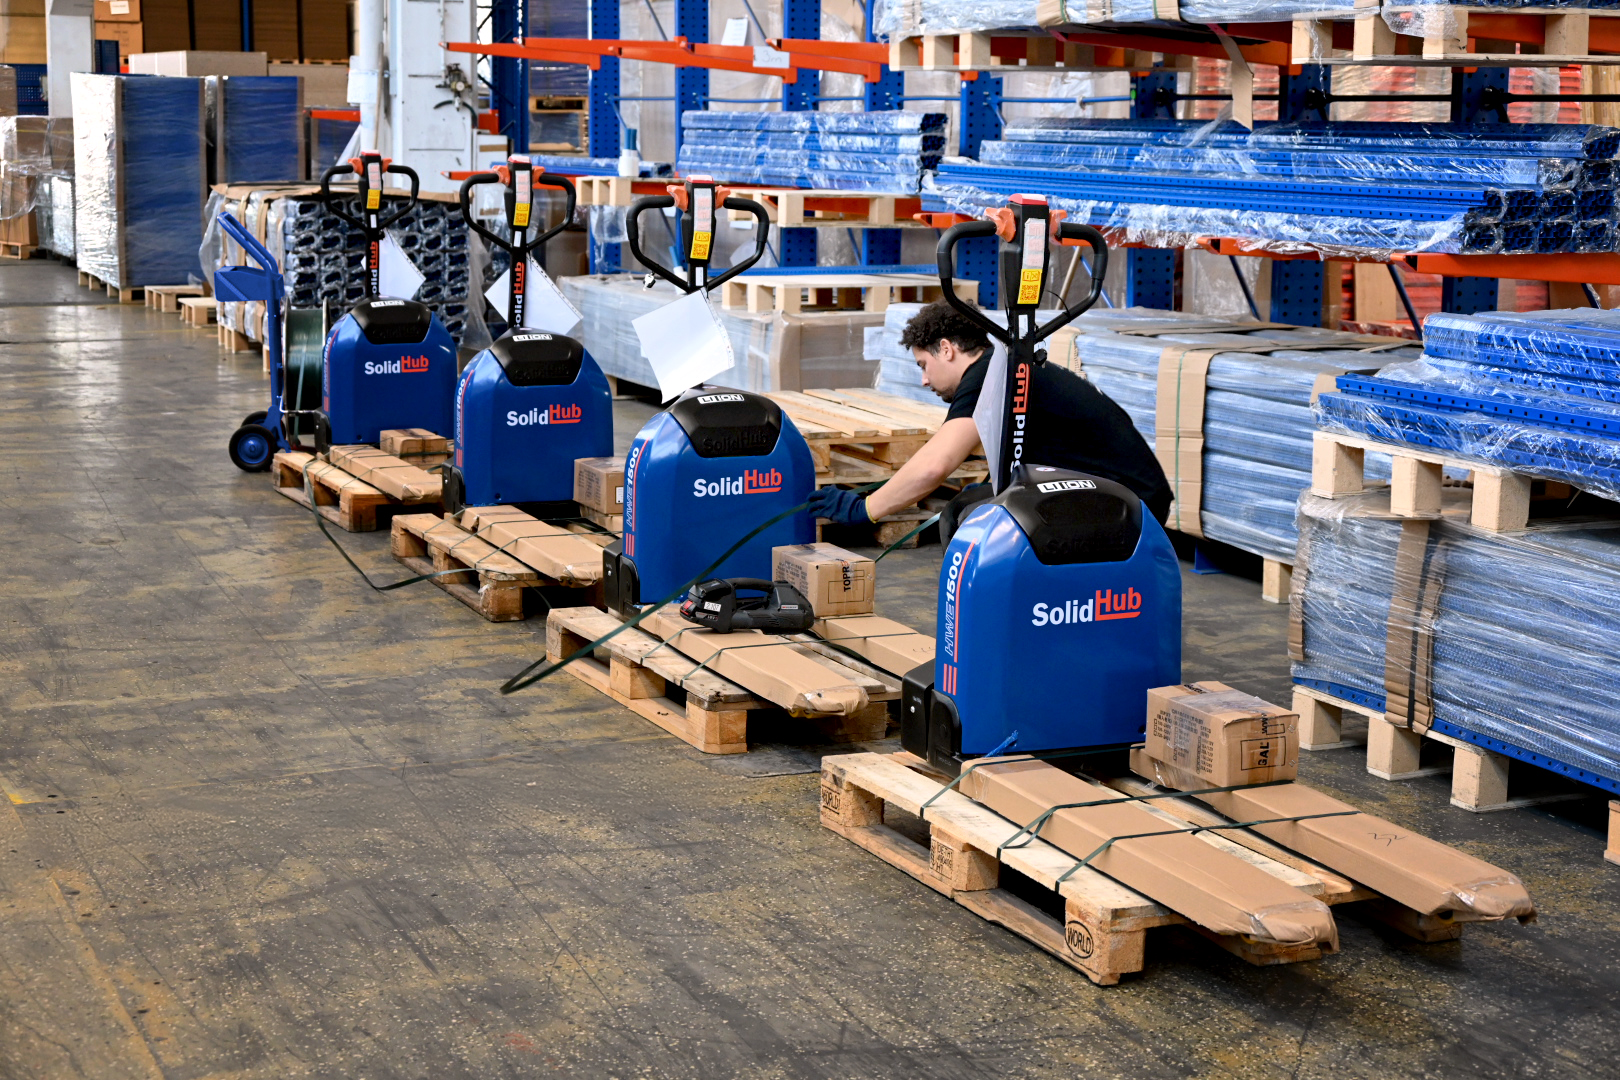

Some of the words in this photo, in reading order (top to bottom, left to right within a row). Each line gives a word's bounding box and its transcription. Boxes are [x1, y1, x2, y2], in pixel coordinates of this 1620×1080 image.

[369, 241, 379, 294] olidHub
[364, 355, 430, 375] SolidHub
[506, 403, 582, 427] SolidHub
[626, 447, 640, 527] HWE1500
[693, 467, 783, 498] SolidHub
[1060, 480, 1094, 490] ION
[944, 552, 963, 656] HWE1500
[1031, 587, 1142, 627] SolidHub
[1066, 926, 1091, 954] WORLD
